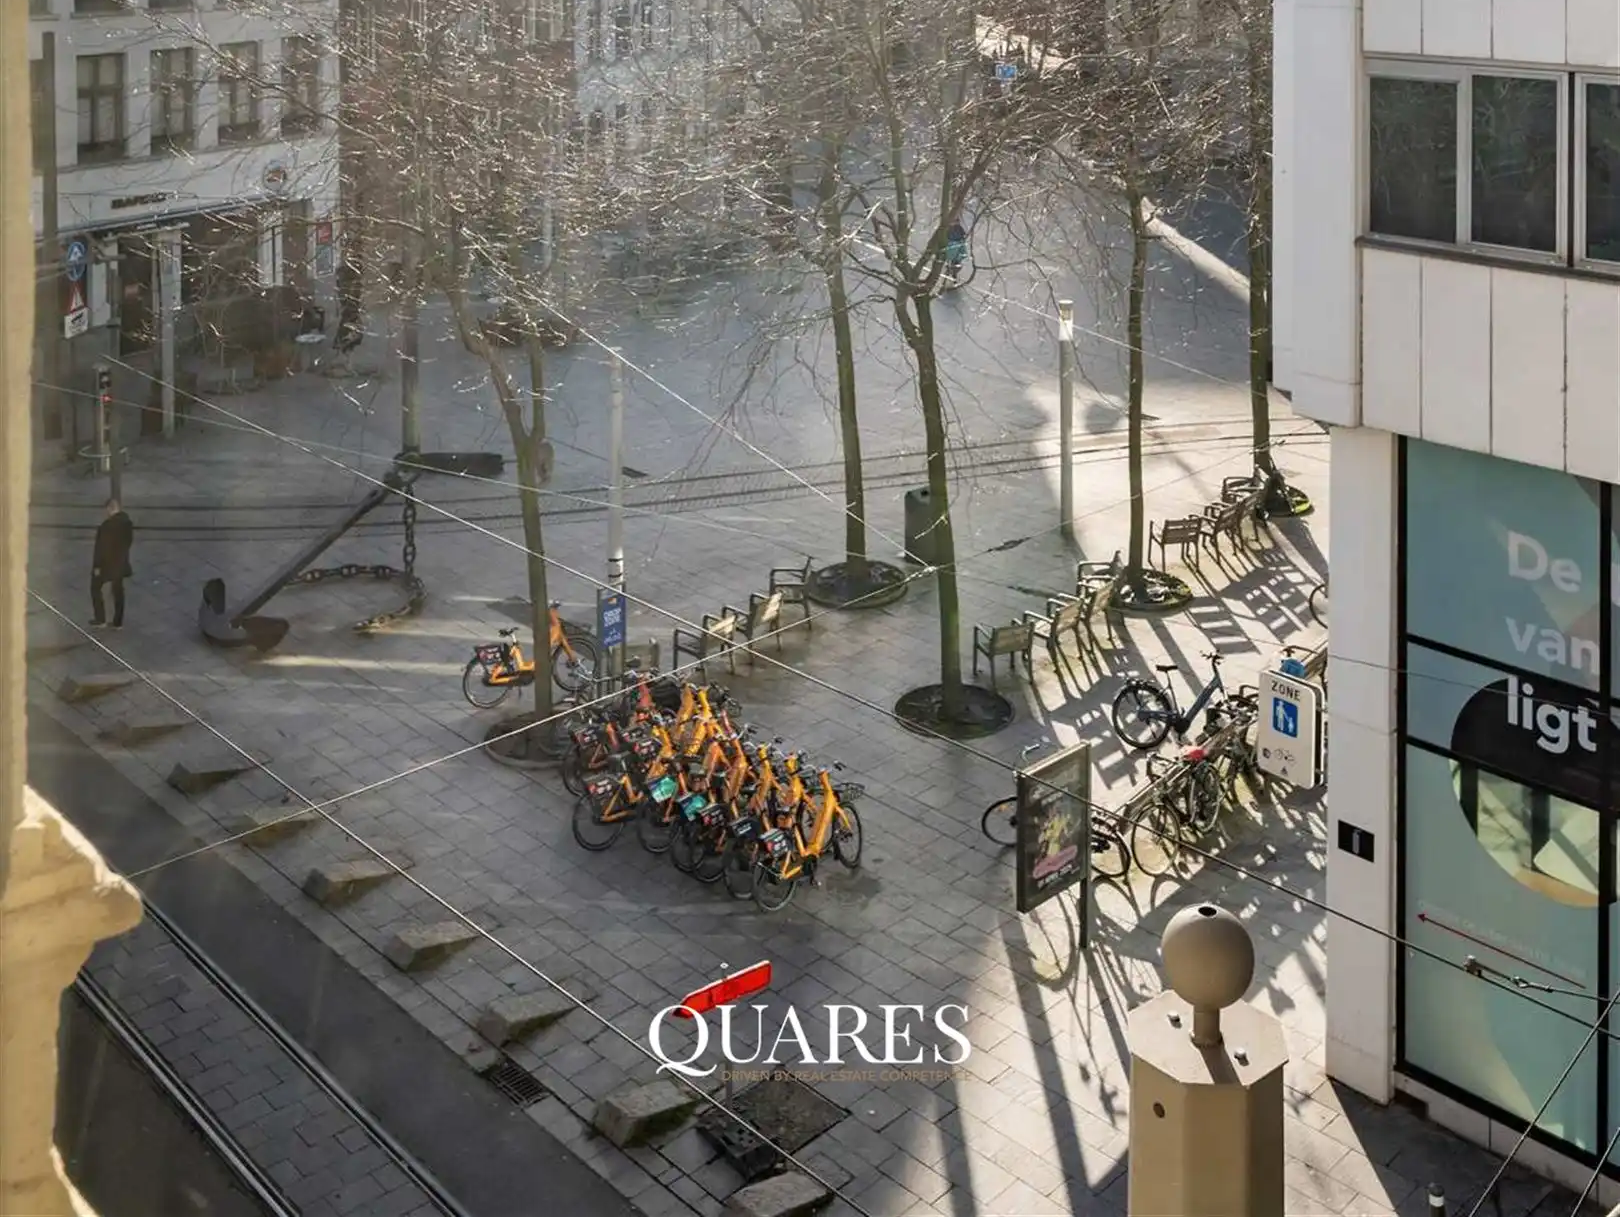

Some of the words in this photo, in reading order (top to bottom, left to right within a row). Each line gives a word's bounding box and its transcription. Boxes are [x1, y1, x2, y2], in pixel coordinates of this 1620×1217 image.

[1508, 530, 1582, 593] De
[1504, 616, 1600, 675] van
[1271, 680, 1301, 702] ZONE
[1507, 674, 1598, 755] ligt
